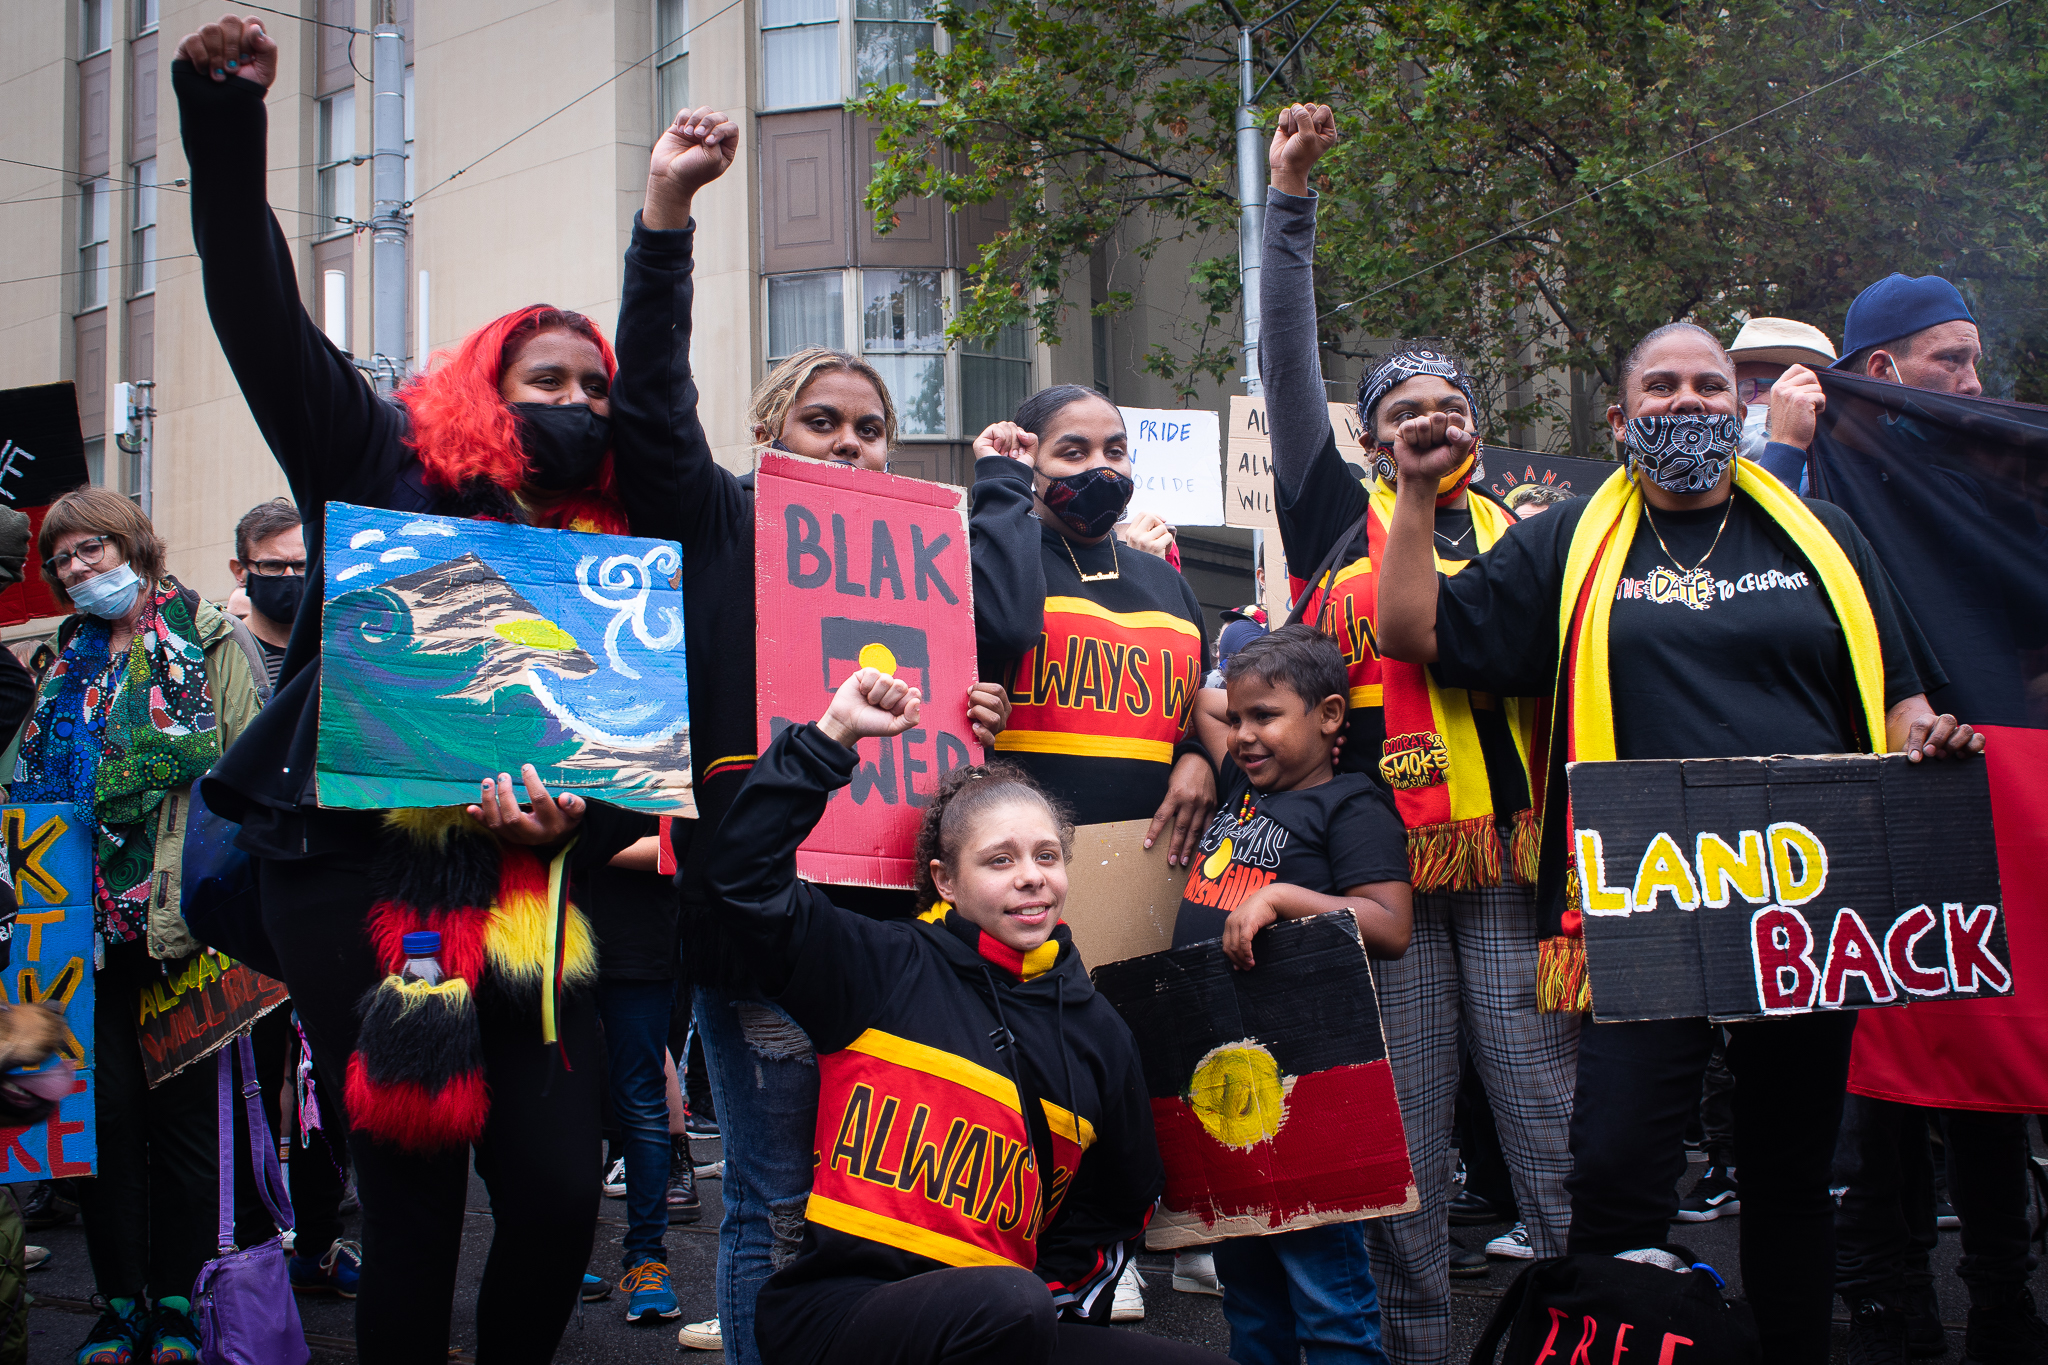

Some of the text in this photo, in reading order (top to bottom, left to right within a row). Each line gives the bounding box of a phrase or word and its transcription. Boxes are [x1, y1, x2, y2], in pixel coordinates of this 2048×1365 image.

[1139, 419, 1191, 442] PRIDE
[784, 503, 959, 606] BLAK
[1616, 568, 1809, 606] THE DATE TO CELEBRATE
[1004, 631, 1153, 717] LWAYS
[1380, 748, 1449, 782] SMOKE
[1384, 733, 1433, 755] BOORAIS
[1574, 821, 1829, 917] LAND
[140, 951, 237, 1026] ALWA
[1750, 902, 2013, 1015] BACK
[142, 990, 226, 1063] WILL
[830, 1081, 1035, 1232] ALWAYS
